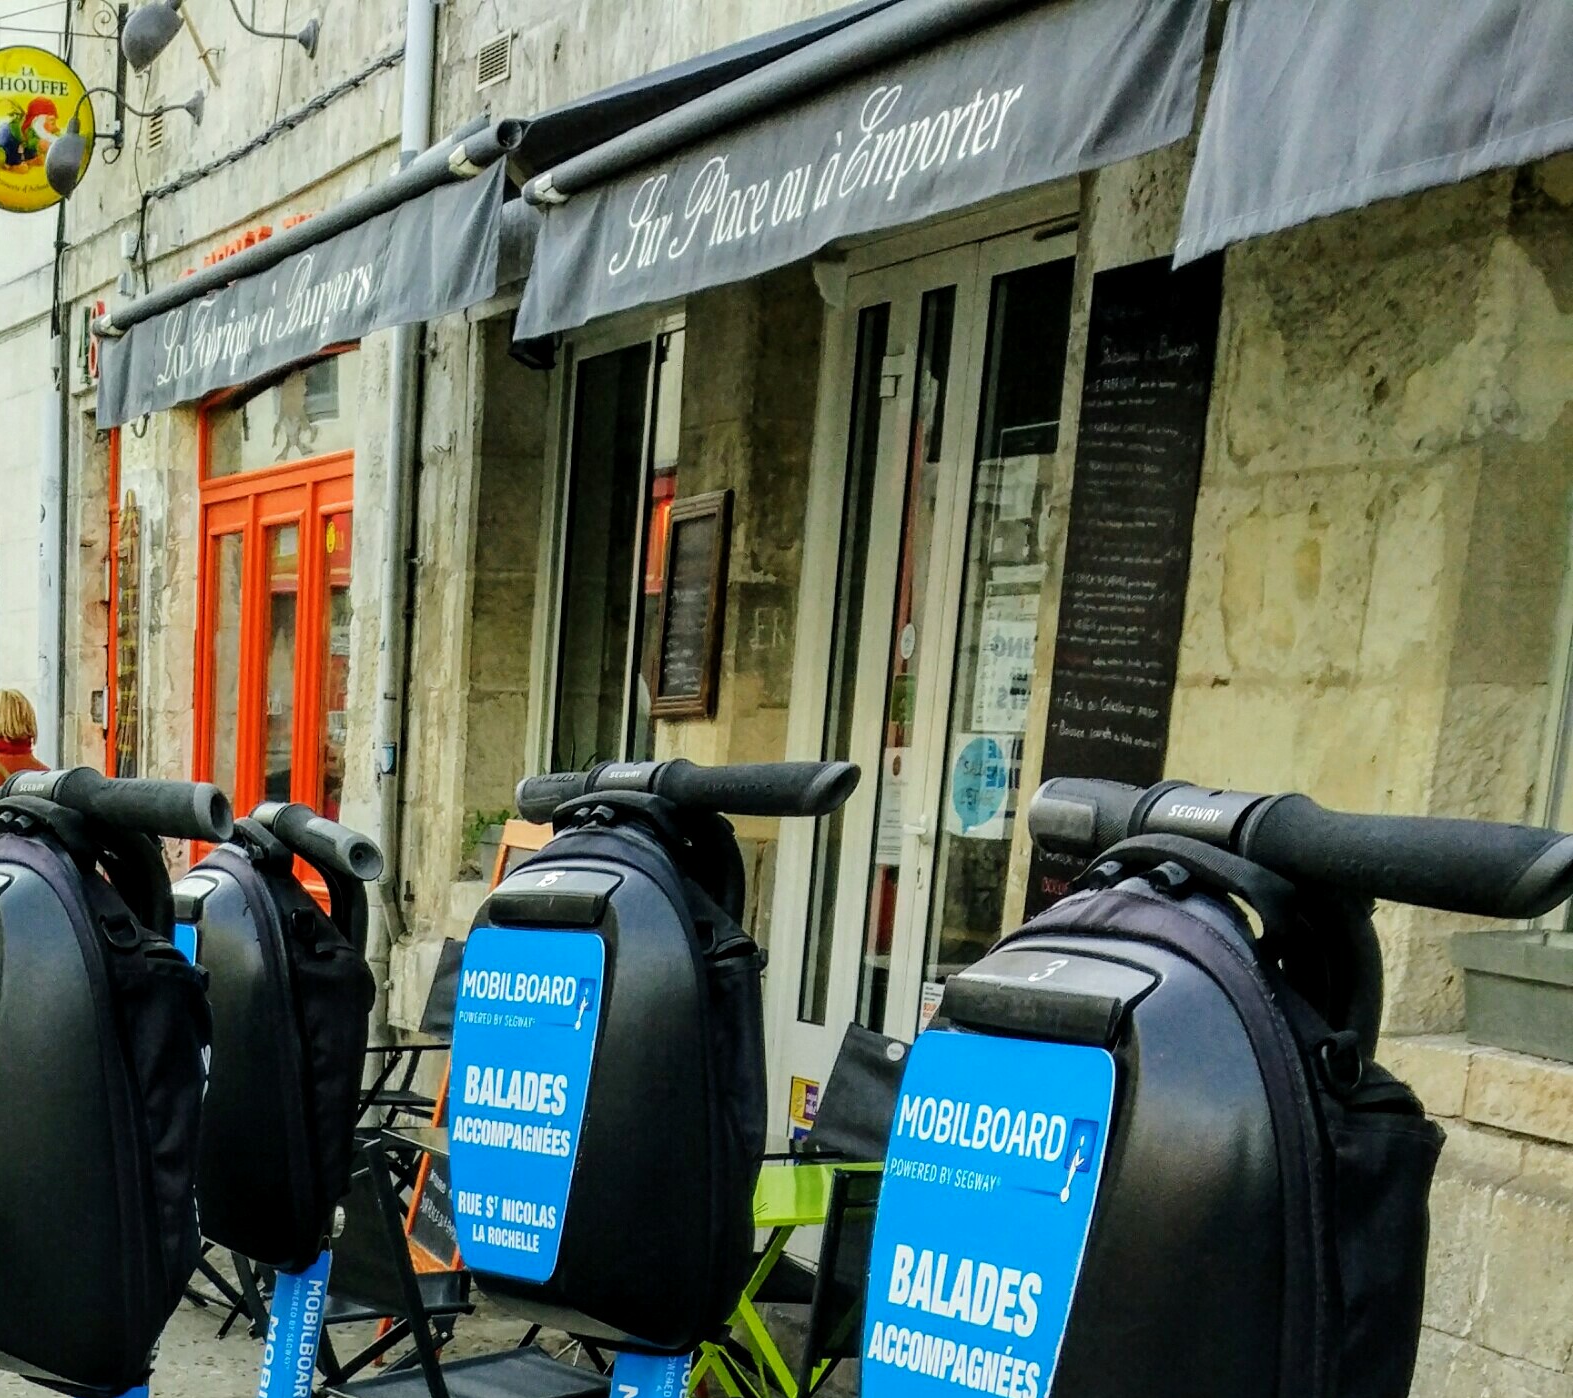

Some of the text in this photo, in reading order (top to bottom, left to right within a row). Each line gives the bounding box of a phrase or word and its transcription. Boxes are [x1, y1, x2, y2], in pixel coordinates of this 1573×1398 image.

[22, 67, 35, 76] LA
[608, 84, 1024, 276] Sur Place ou à Emporter
[185, 300, 259, 376] Fabrique
[278, 252, 373, 340] Burgers
[1167, 803, 1224, 823] SEGWAY
[462, 969, 577, 1007] MOBILBOARD
[458, 1011, 493, 1026] POWERED
[494, 1013, 503, 1026] BY
[464, 1065, 568, 1116] BALADES
[452, 1117, 570, 1157] ACCOMPAGNÉES
[896, 1094, 1067, 1162] MOBILBOARD
[890, 1157, 937, 1182] POWERED
[939, 1168, 953, 1186] BY
[458, 1191, 482, 1217] RUE
[502, 1197, 557, 1230] NICOLAS
[472, 1223, 540, 1253] LA ROCHELLE
[888, 1244, 1043, 1338] BALADES
